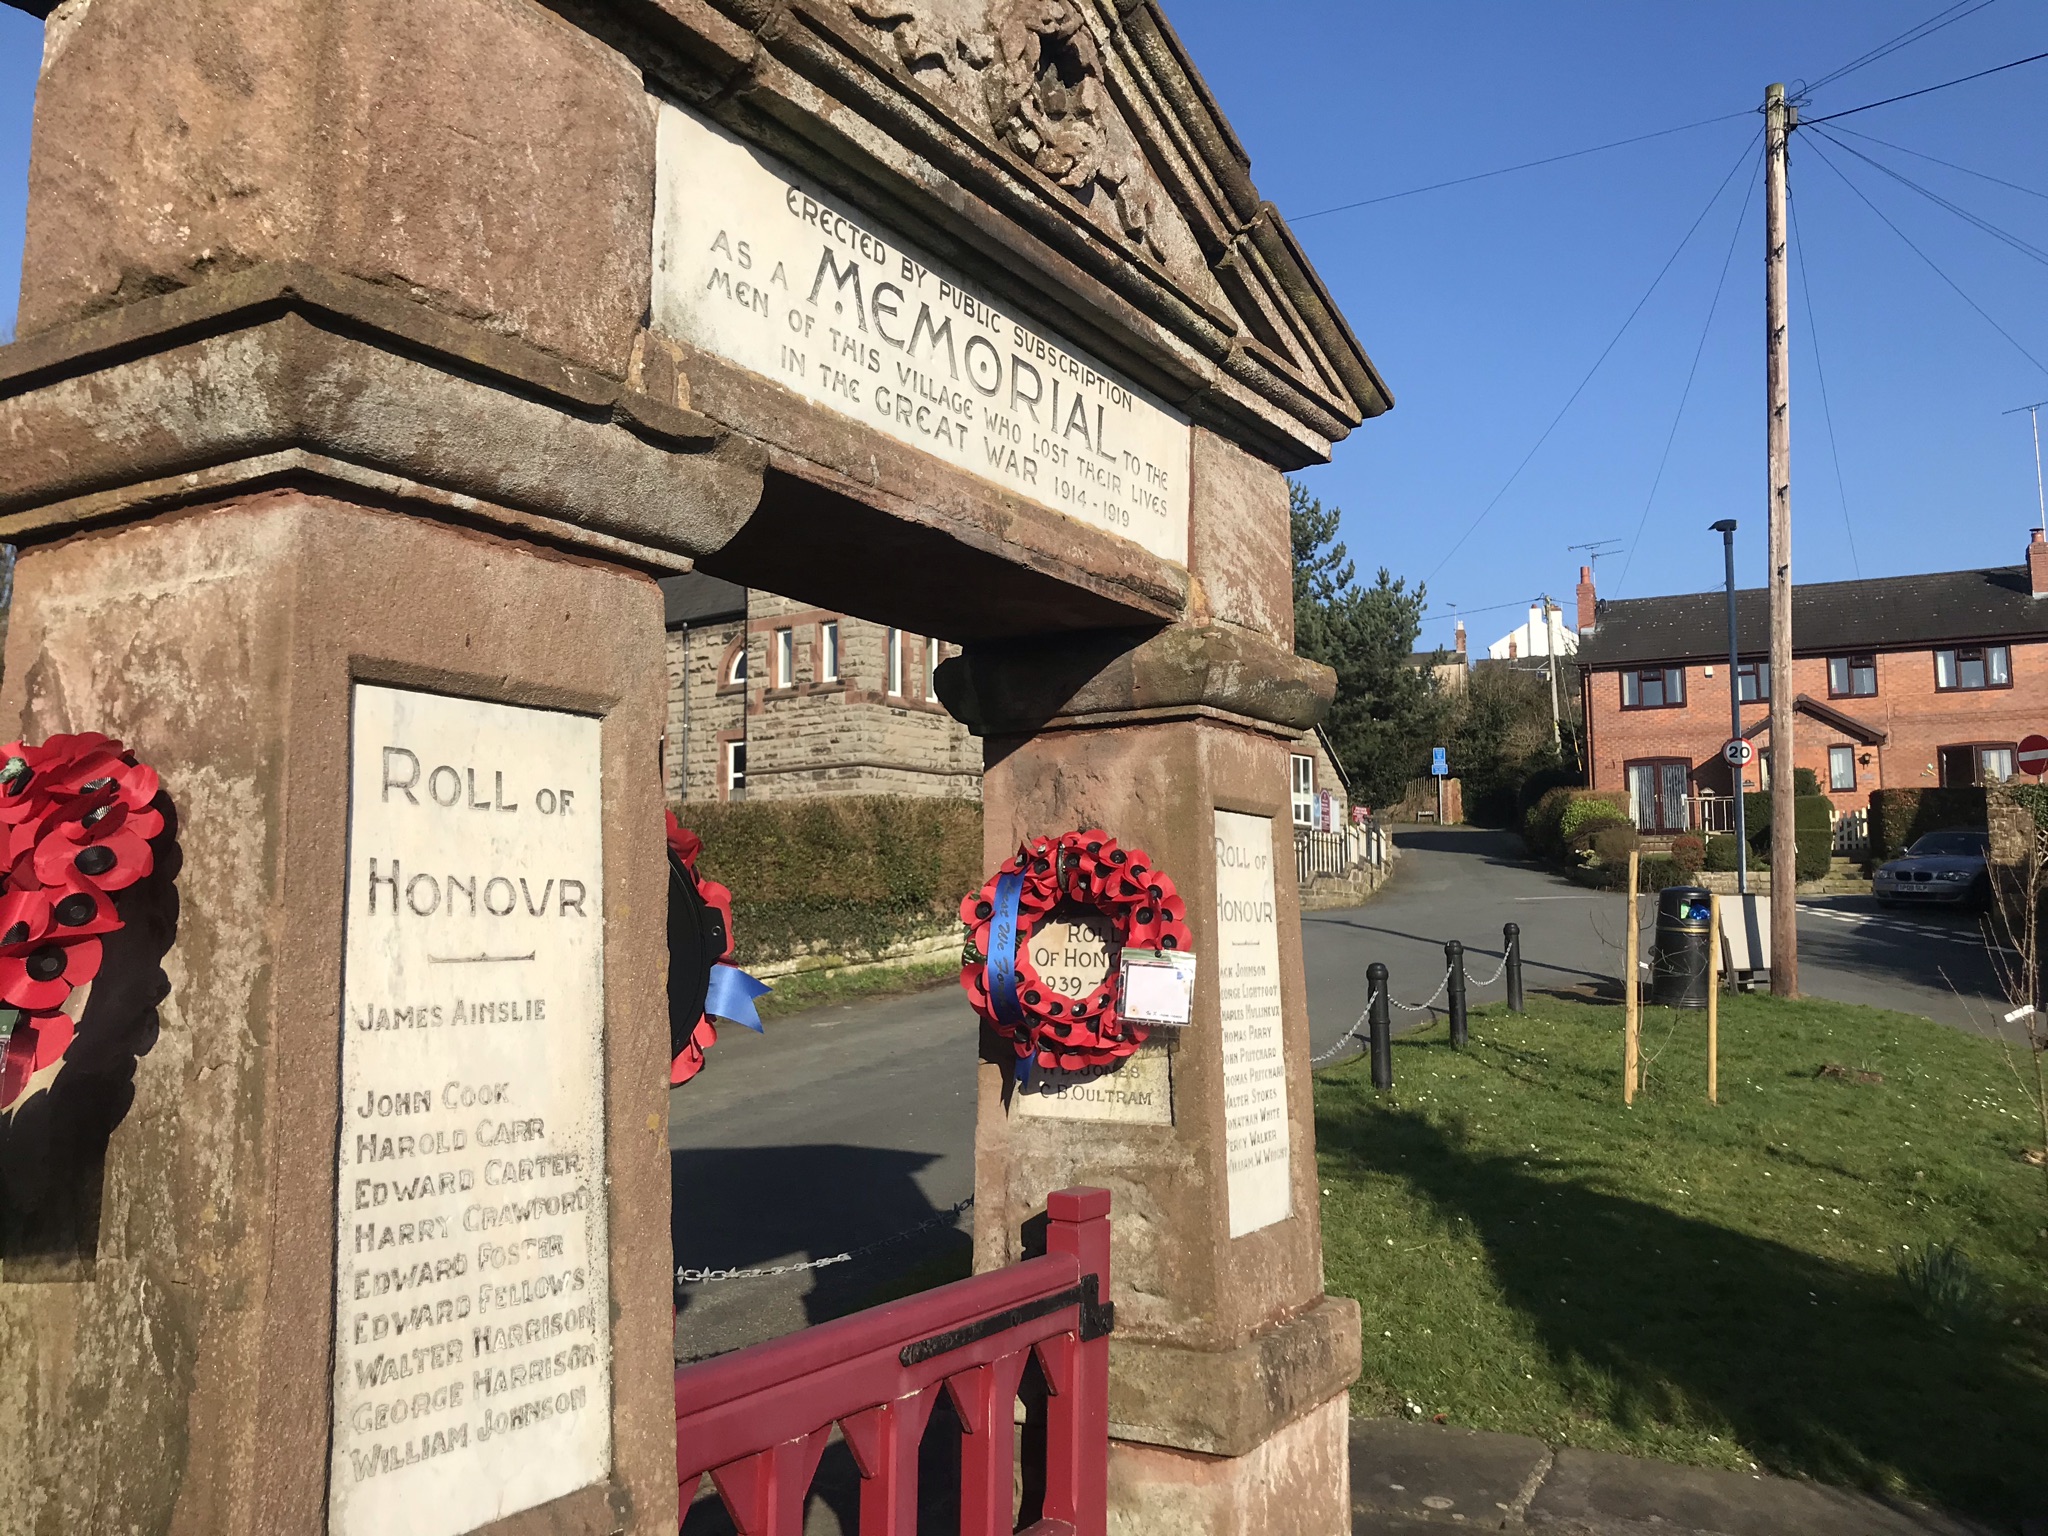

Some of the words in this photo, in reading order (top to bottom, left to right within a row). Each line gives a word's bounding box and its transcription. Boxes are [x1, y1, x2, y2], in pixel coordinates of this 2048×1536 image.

[786, 186, 886, 265] ERECTED
[901, 255, 927, 289] BY
[939, 280, 1000, 333] PUBLIC
[1013, 326, 1132, 412] SUBSCRIPTION
[710, 229, 752, 270] AS
[770, 261, 788, 291] A
[806, 244, 1117, 464] MEMORIAL
[1123, 450, 1141, 476] TO
[1145, 462, 1168, 492] THE
[706, 267, 769, 318] MEN
[788, 309, 815, 339] OF
[829, 327, 880, 374] THIS
[896, 361, 973, 420] VILLAGE
[983, 406, 1022, 444] WHO
[1033, 432, 1069, 468] LOST
[1076, 456, 1122, 496] THEIR
[1131, 484, 1167, 518] LIVES
[781, 344, 806, 377] IN
[818, 363, 861, 403] THE
[875, 385, 969, 450] GREAT
[983, 436, 1038, 486] WAR
[1054, 476, 1086, 508] 1914
[1103, 500, 1130, 528] 1919
[1729, 746, 1750, 759] 20
[381, 746, 519, 814] ROLL
[535, 788, 575, 817] OF
[1254, 855, 1267, 870] OF
[999, 879, 1015, 917] Lest
[997, 922, 1010, 952] We
[1068, 924, 1120, 943] ROLL
[1035, 948, 1059, 967] OF
[1220, 967, 1233, 978] ACK
[1039, 976, 1082, 996] 939
[1220, 988, 1240, 1000] EORGE
[357, 1001, 443, 1032] JAMES
[450, 999, 546, 1026] AINSLIE
[1225, 1052, 1238, 1065] OHN
[1223, 1072, 1248, 1087] HOMAS
[356, 1089, 431, 1119] JOHN
[441, 1080, 510, 1111] COOK
[355, 1128, 468, 1164] HAROLD
[475, 1117, 545, 1148] CARR
[1227, 1113, 1259, 1130] ONATHAN
[354, 1168, 474, 1211] EDWARD
[484, 1150, 583, 1186] CARTER
[355, 1216, 453, 1254] HARRY
[462, 1187, 592, 1233] CRAWFORD
[353, 1252, 468, 1300] EDWARD
[478, 1234, 565, 1272] FOSTER
[353, 1294, 471, 1345] EDWARD
[478, 1267, 586, 1314] FELLOWS
[354, 1339, 464, 1390] WALTER
[472, 1303, 597, 1359] HARRISON
[351, 1382, 464, 1435] GEORGE
[472, 1342, 597, 1397] HARRISON
[349, 1422, 469, 1482] WILLIAM
[477, 1384, 587, 1443] JOHNSON
